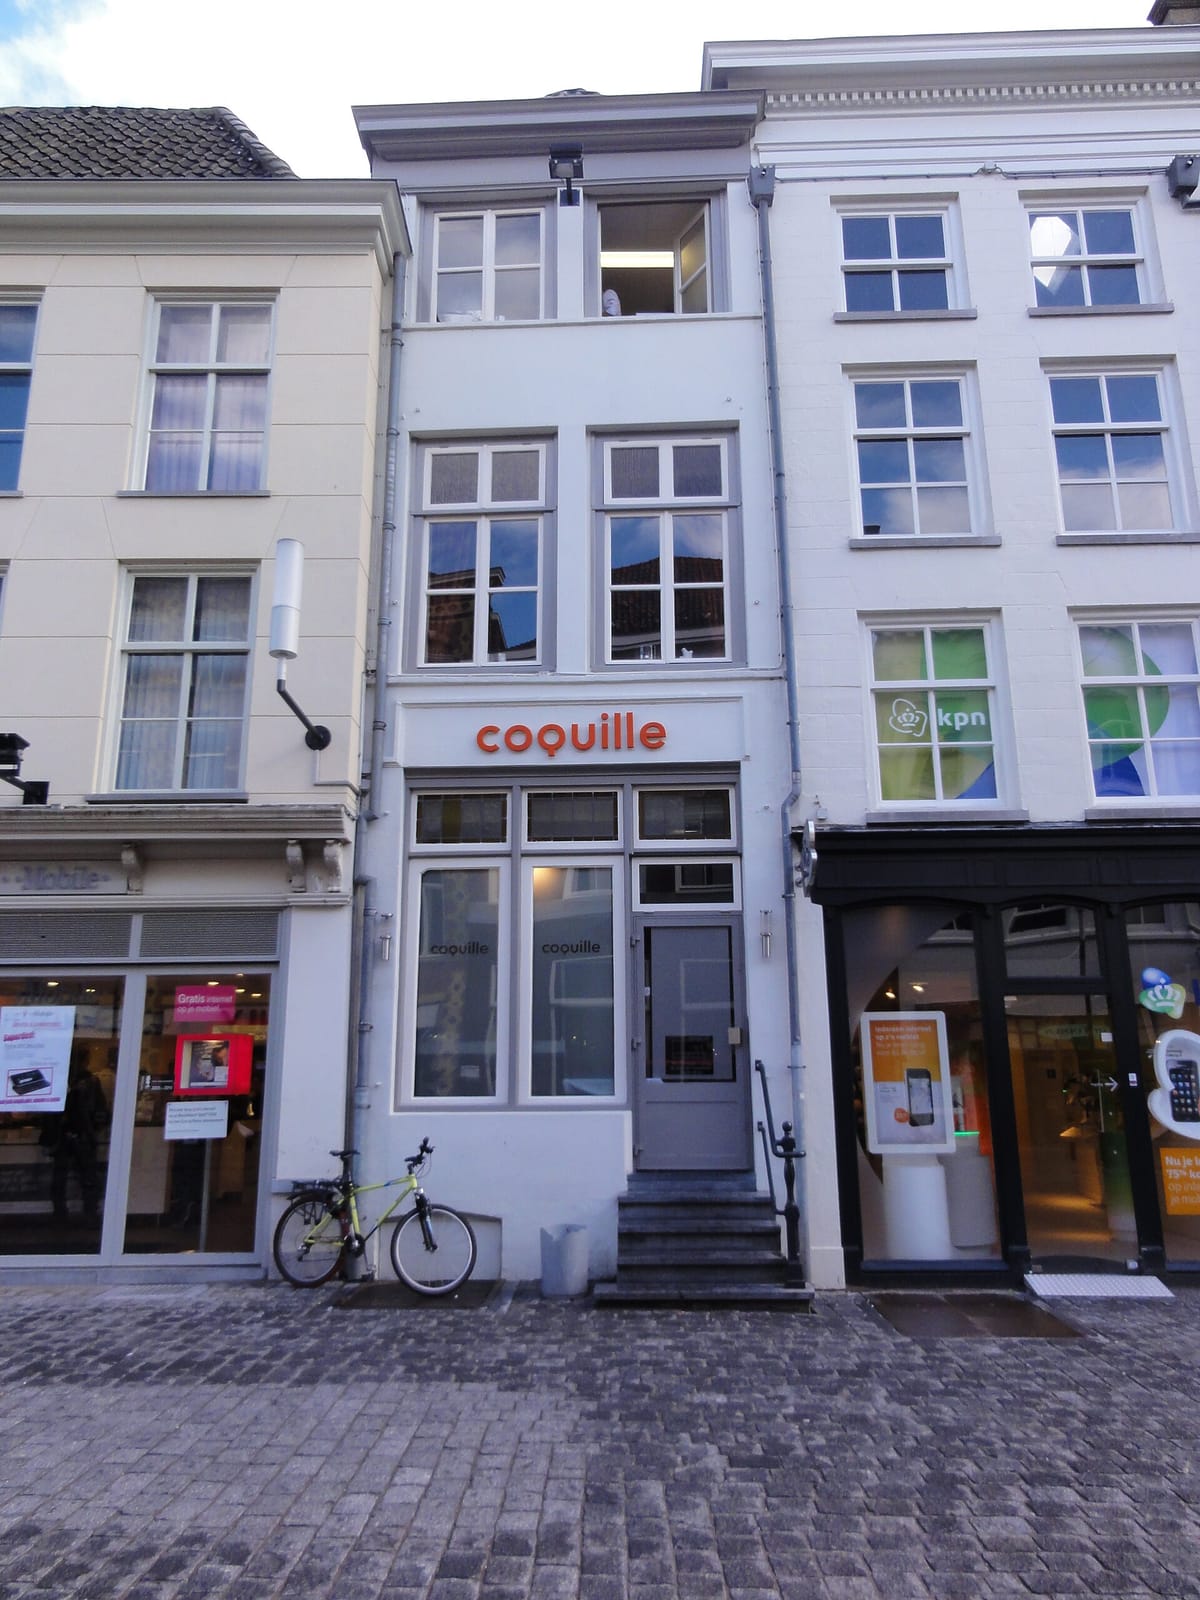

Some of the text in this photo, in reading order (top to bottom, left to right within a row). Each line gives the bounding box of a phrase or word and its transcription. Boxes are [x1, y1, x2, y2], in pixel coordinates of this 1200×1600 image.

[937, 708, 986, 731] kpn
[476, 711, 667, 757] coquille
[431, 941, 489, 956] coquille
[542, 940, 601, 954] coquille
[178, 993, 206, 1004] Gratis
[1164, 1155, 1181, 1167] Nu
[1182, 1155, 1192, 1168] je
[1168, 1183, 1182, 1193] op
